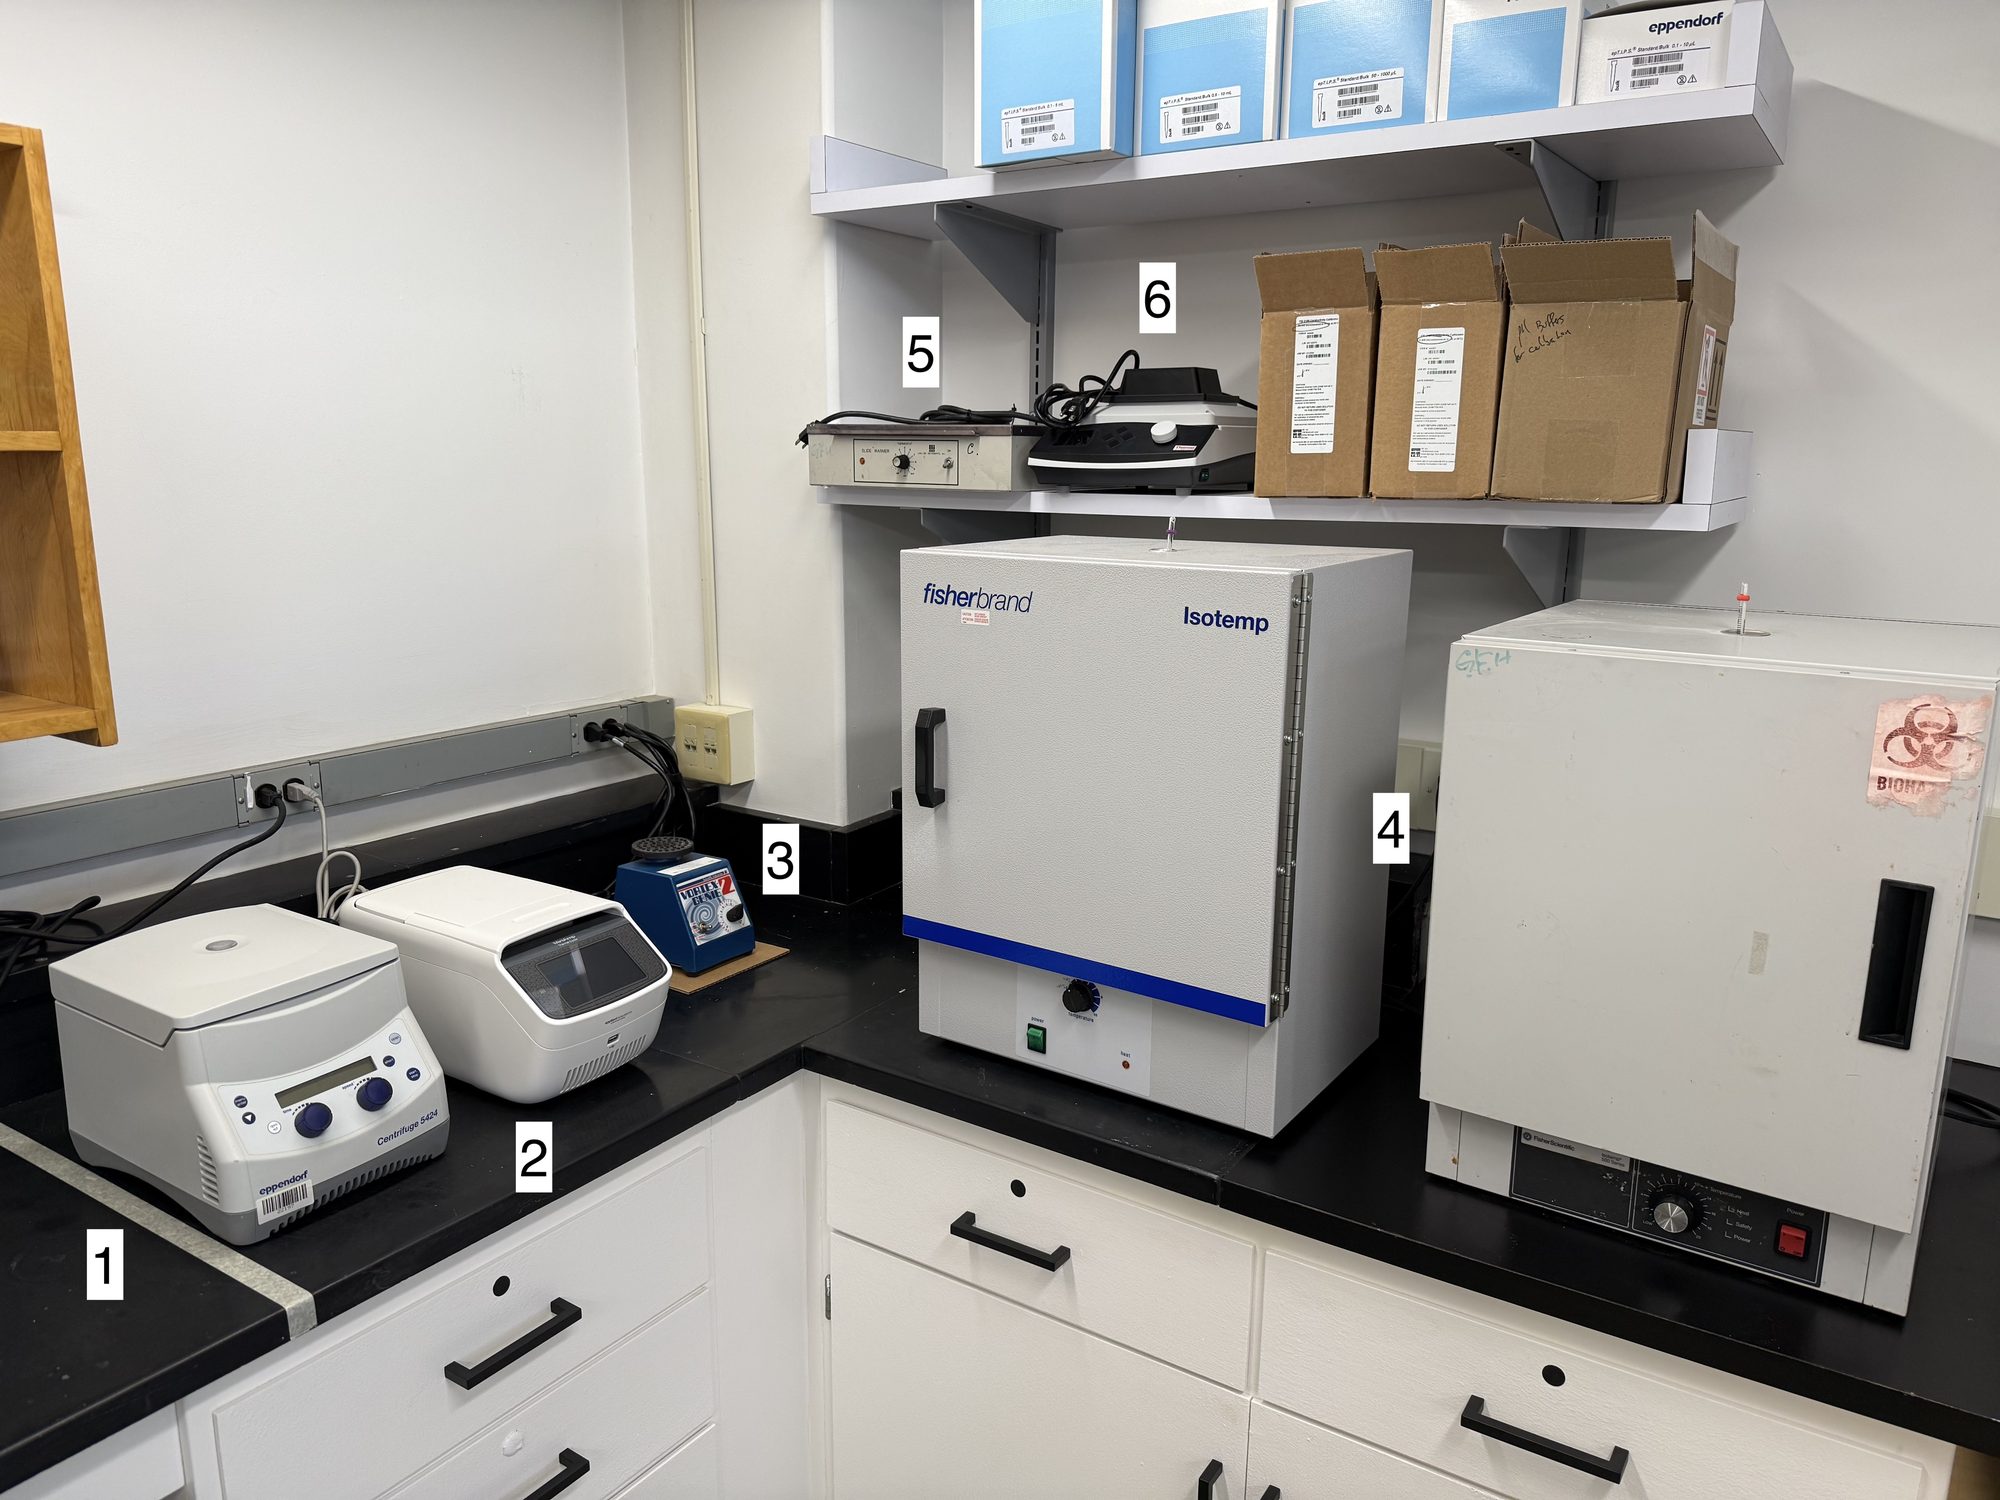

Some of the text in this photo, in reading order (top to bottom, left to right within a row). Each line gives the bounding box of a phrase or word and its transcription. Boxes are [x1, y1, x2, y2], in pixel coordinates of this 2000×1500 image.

[1649, 12, 1724, 35] eppendorf
[1637, 44, 1659, 53] Standard
[923, 583, 1033, 613] fisherbrand
[1184, 606, 1269, 635] Isotemp
[718, 875, 735, 896] 2
[692, 890, 721, 905] GENIE
[377, 1108, 438, 1146] Centrifuge 5424
[259, 1170, 308, 1195] eppendorf
[1733, 1234, 1751, 1243] Power
